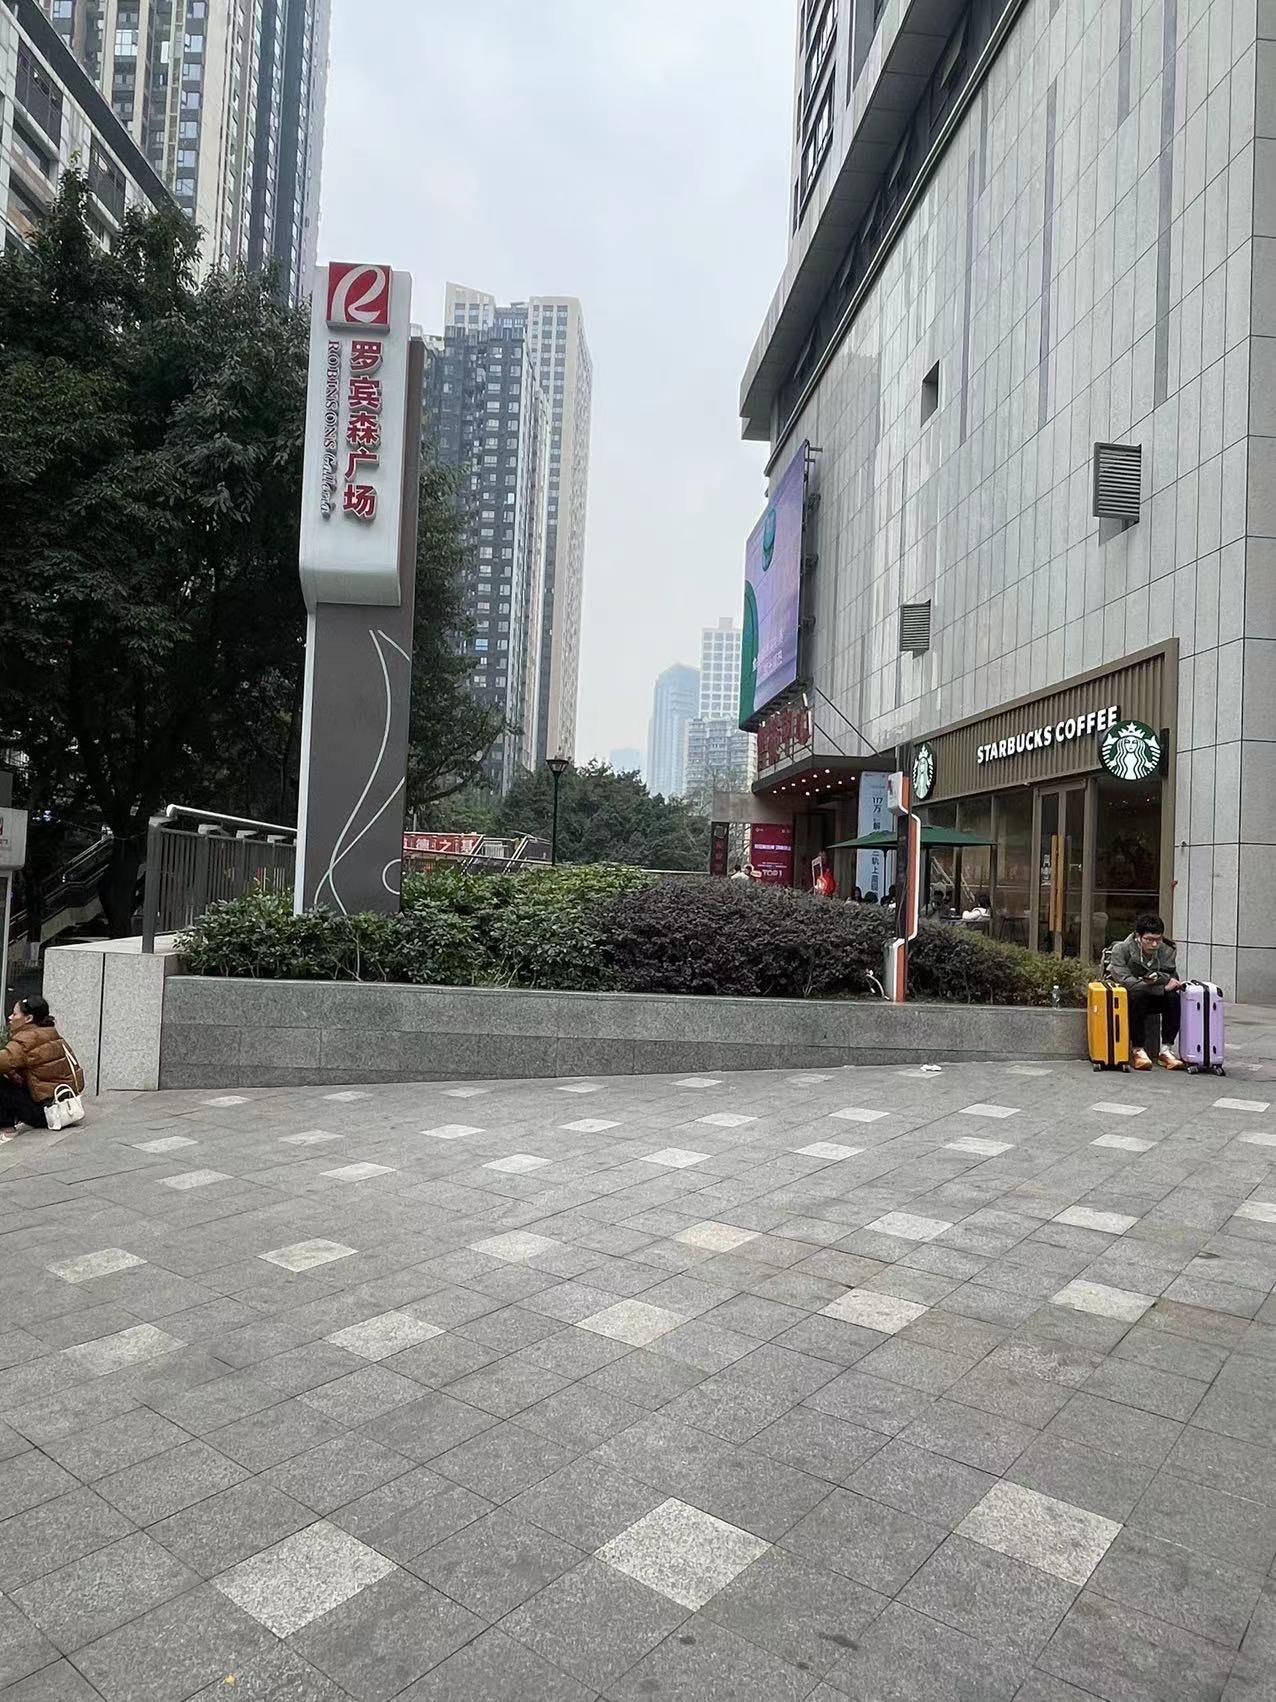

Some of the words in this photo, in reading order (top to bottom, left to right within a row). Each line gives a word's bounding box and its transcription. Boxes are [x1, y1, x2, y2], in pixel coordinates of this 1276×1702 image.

[325, 341, 340, 453] ROBINSONS
[343, 340, 383, 519] 罗宾森广场
[977, 725, 1052, 764] STARBUCKS
[1055, 705, 1118, 742] COFFEE
